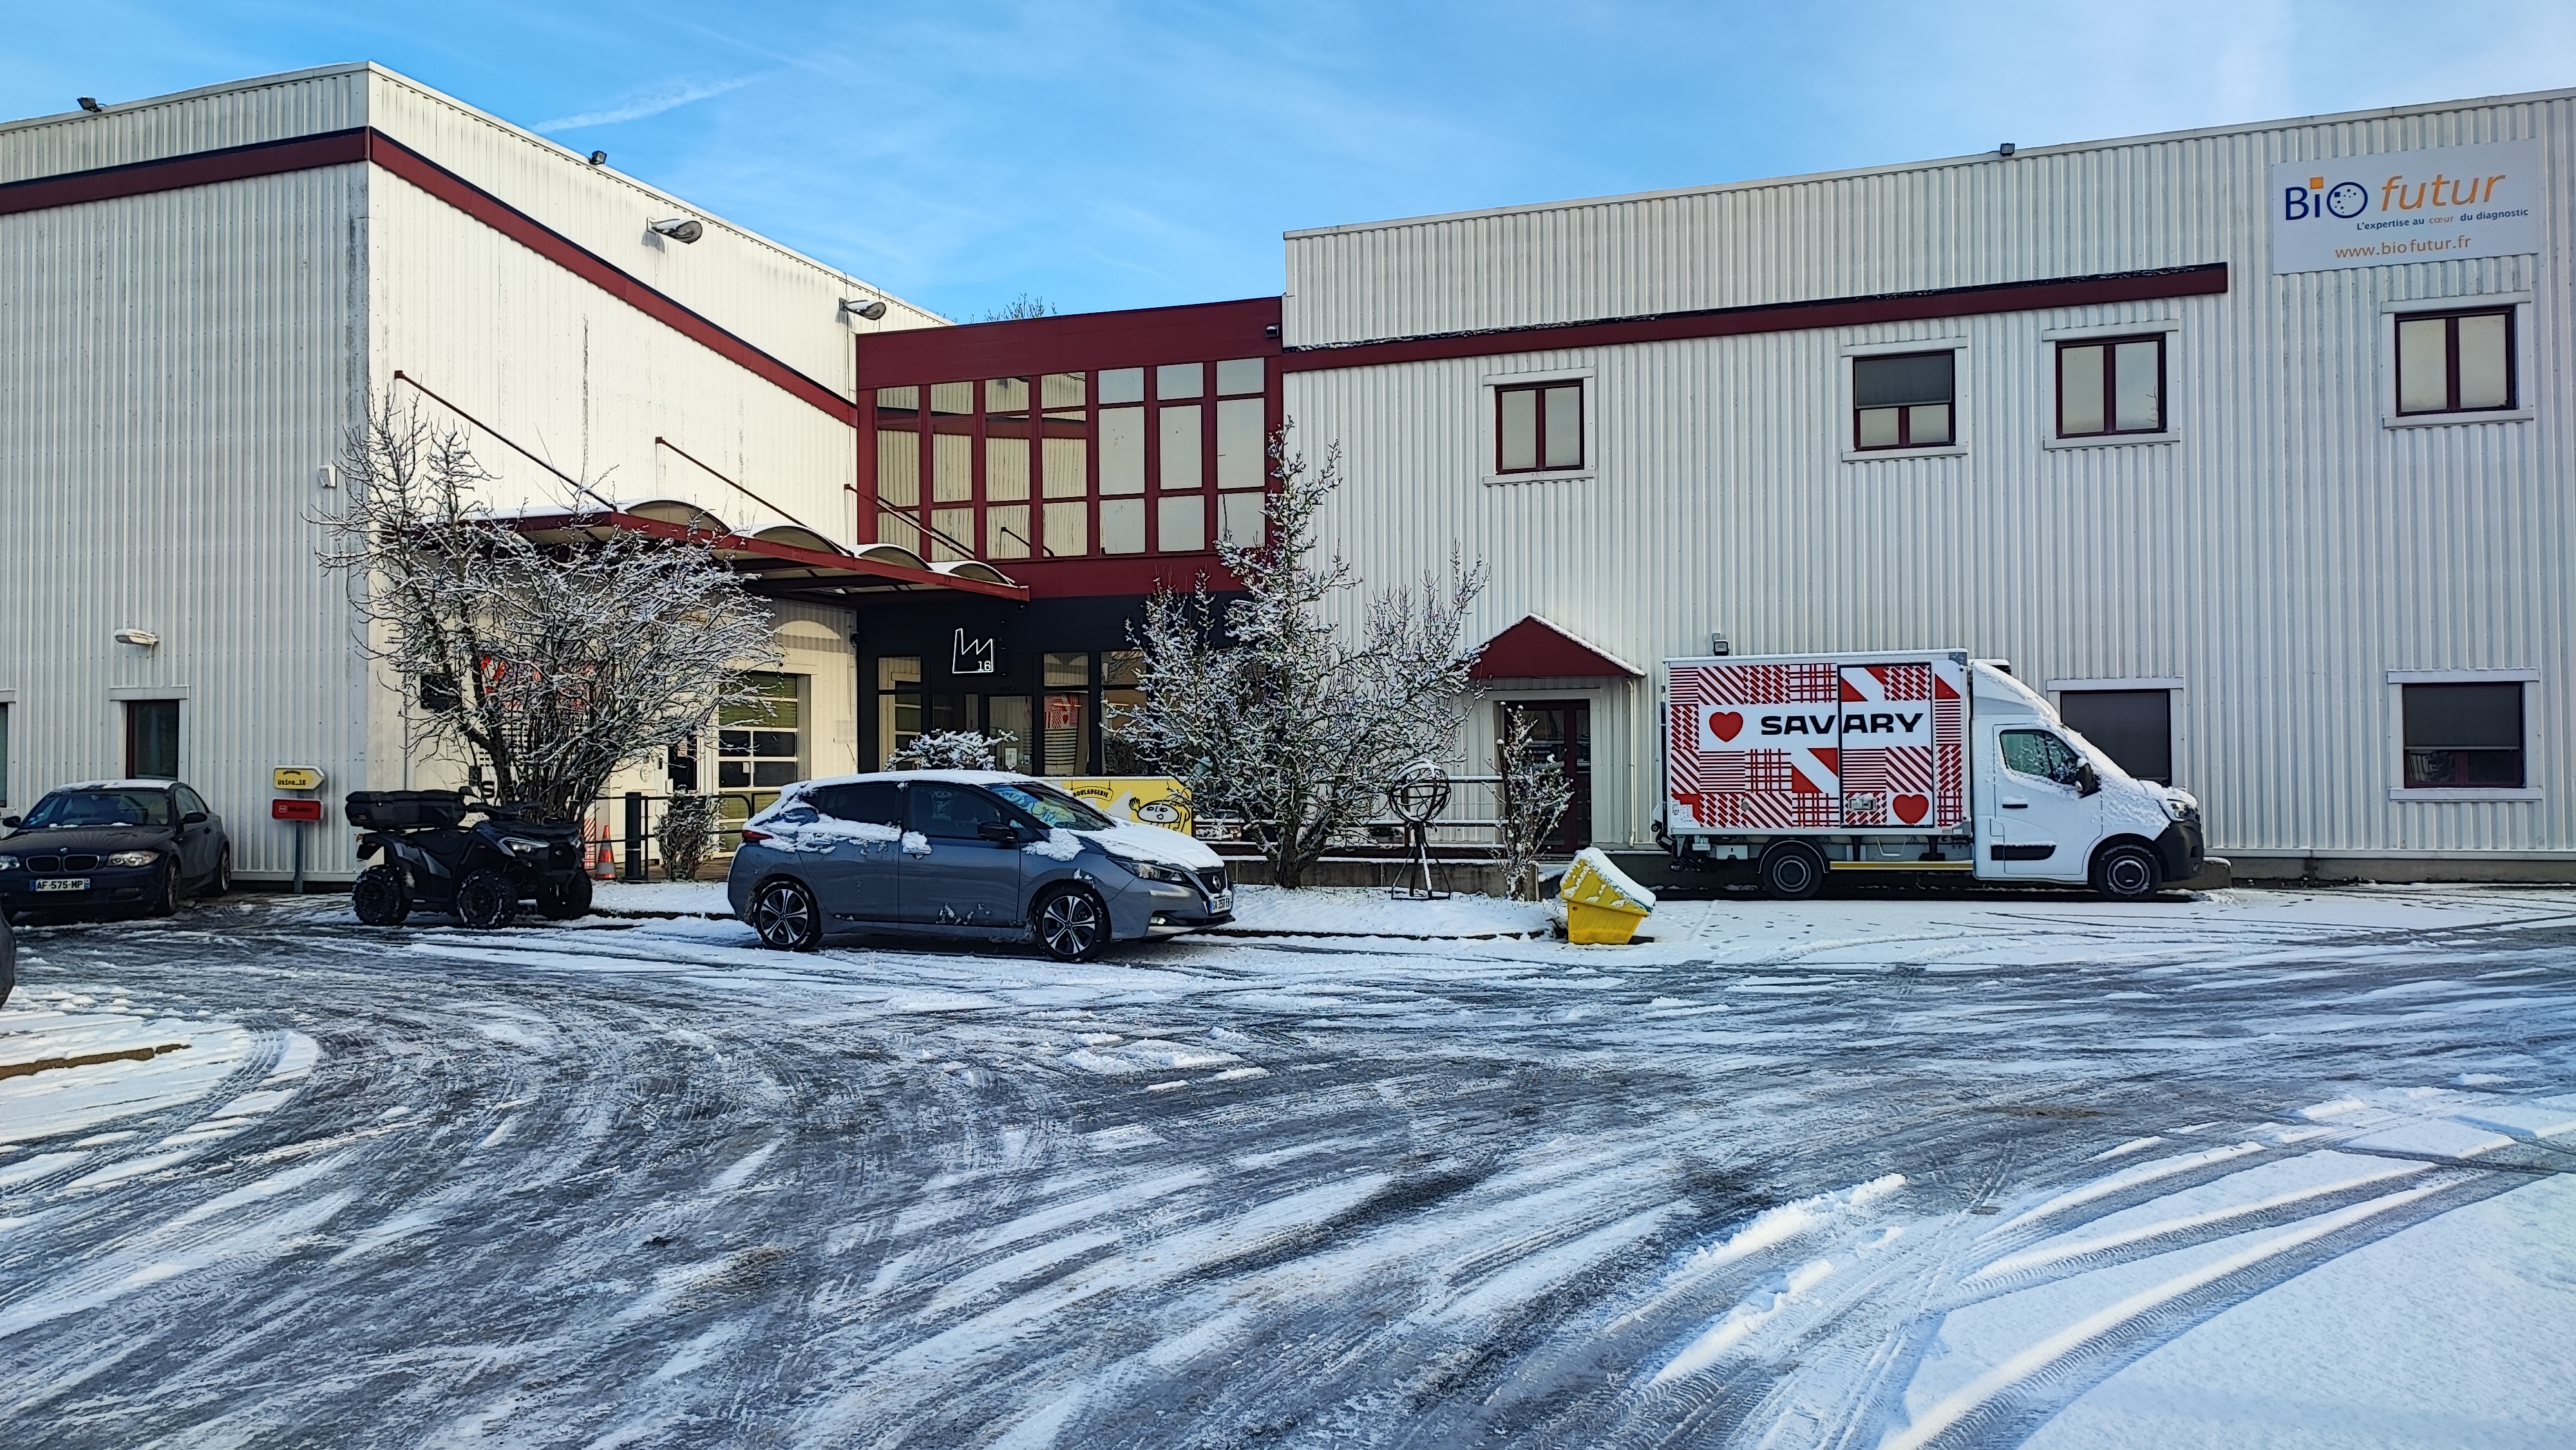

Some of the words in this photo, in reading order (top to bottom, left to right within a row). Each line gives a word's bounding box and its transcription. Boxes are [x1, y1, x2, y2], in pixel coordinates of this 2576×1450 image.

[2382, 174, 2506, 212] futur
[2357, 218, 2410, 231] L'expertise
[2412, 217, 2425, 226] au
[2429, 214, 2454, 224] cœur
[2460, 213, 2474, 222] du
[2476, 208, 2529, 221] diagnostic
[2335, 235, 2471, 258] www.biofutur.fr
[977, 660, 991, 672] 16
[1761, 713, 1924, 735] SAVARY
[1073, 789, 1109, 798] BOULANGERIE
